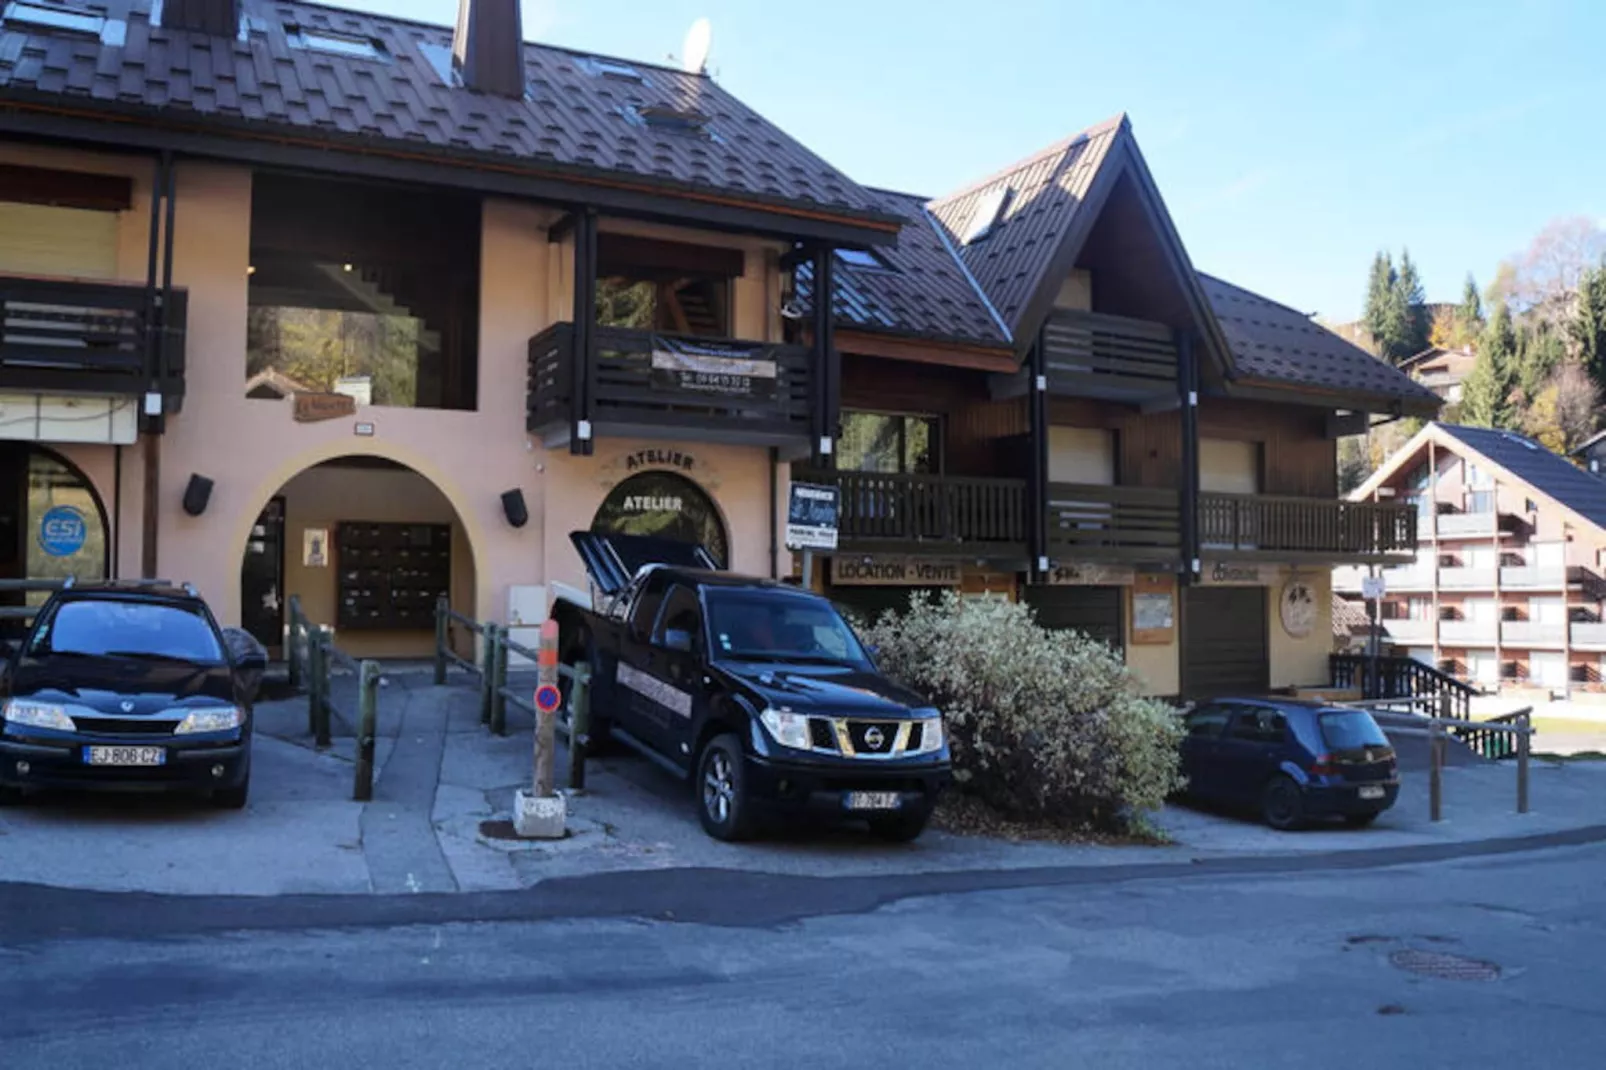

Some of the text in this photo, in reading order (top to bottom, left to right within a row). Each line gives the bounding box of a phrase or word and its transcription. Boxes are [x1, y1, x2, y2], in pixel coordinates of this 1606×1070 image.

[626, 449, 694, 470] ATELIER
[623, 495, 682, 511] ATELIER
[839, 560, 905, 579] LOCATION
[915, 563, 958, 579] VENTE
